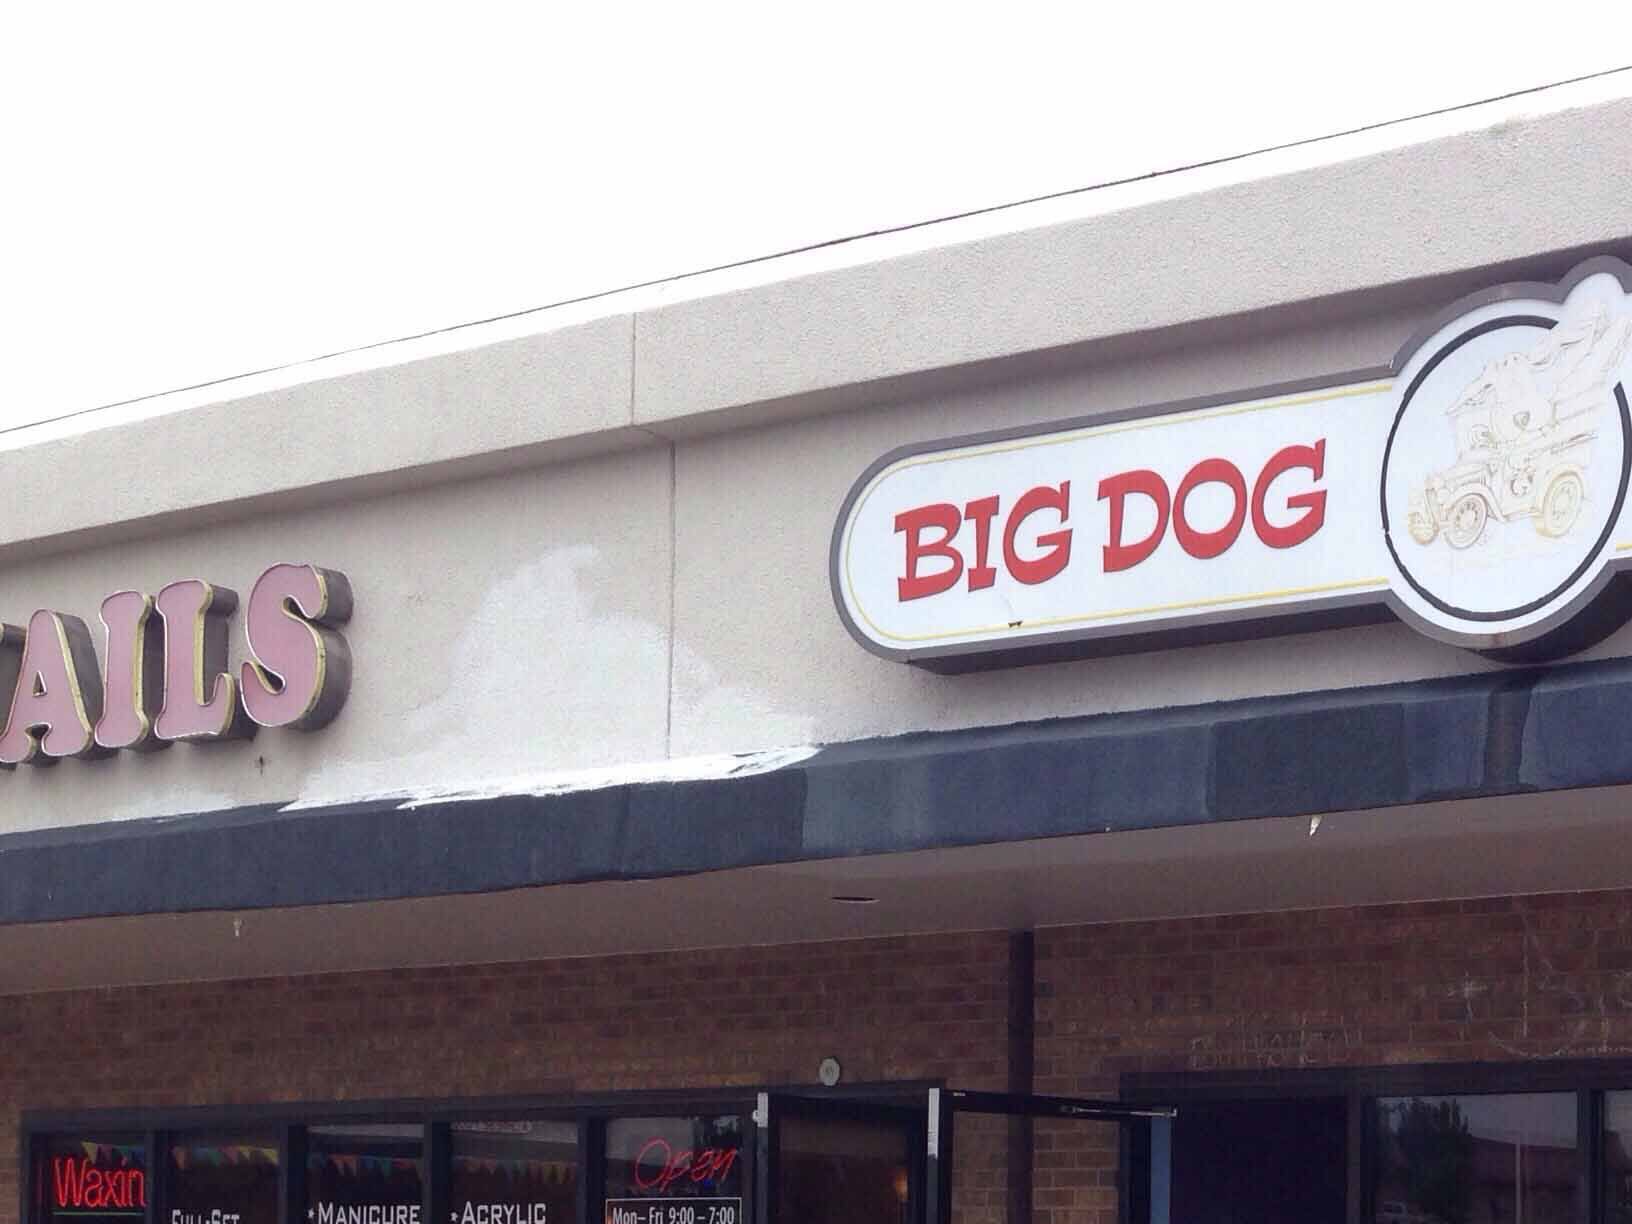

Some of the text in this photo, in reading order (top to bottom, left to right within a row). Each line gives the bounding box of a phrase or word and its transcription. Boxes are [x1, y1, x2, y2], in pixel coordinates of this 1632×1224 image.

[894, 480, 1074, 602] BIG
[1098, 438, 1328, 573] DOG
[0, 562, 345, 765] AILS
[53, 1156, 147, 1208] Waxin
[635, 1137, 737, 1192] Open
